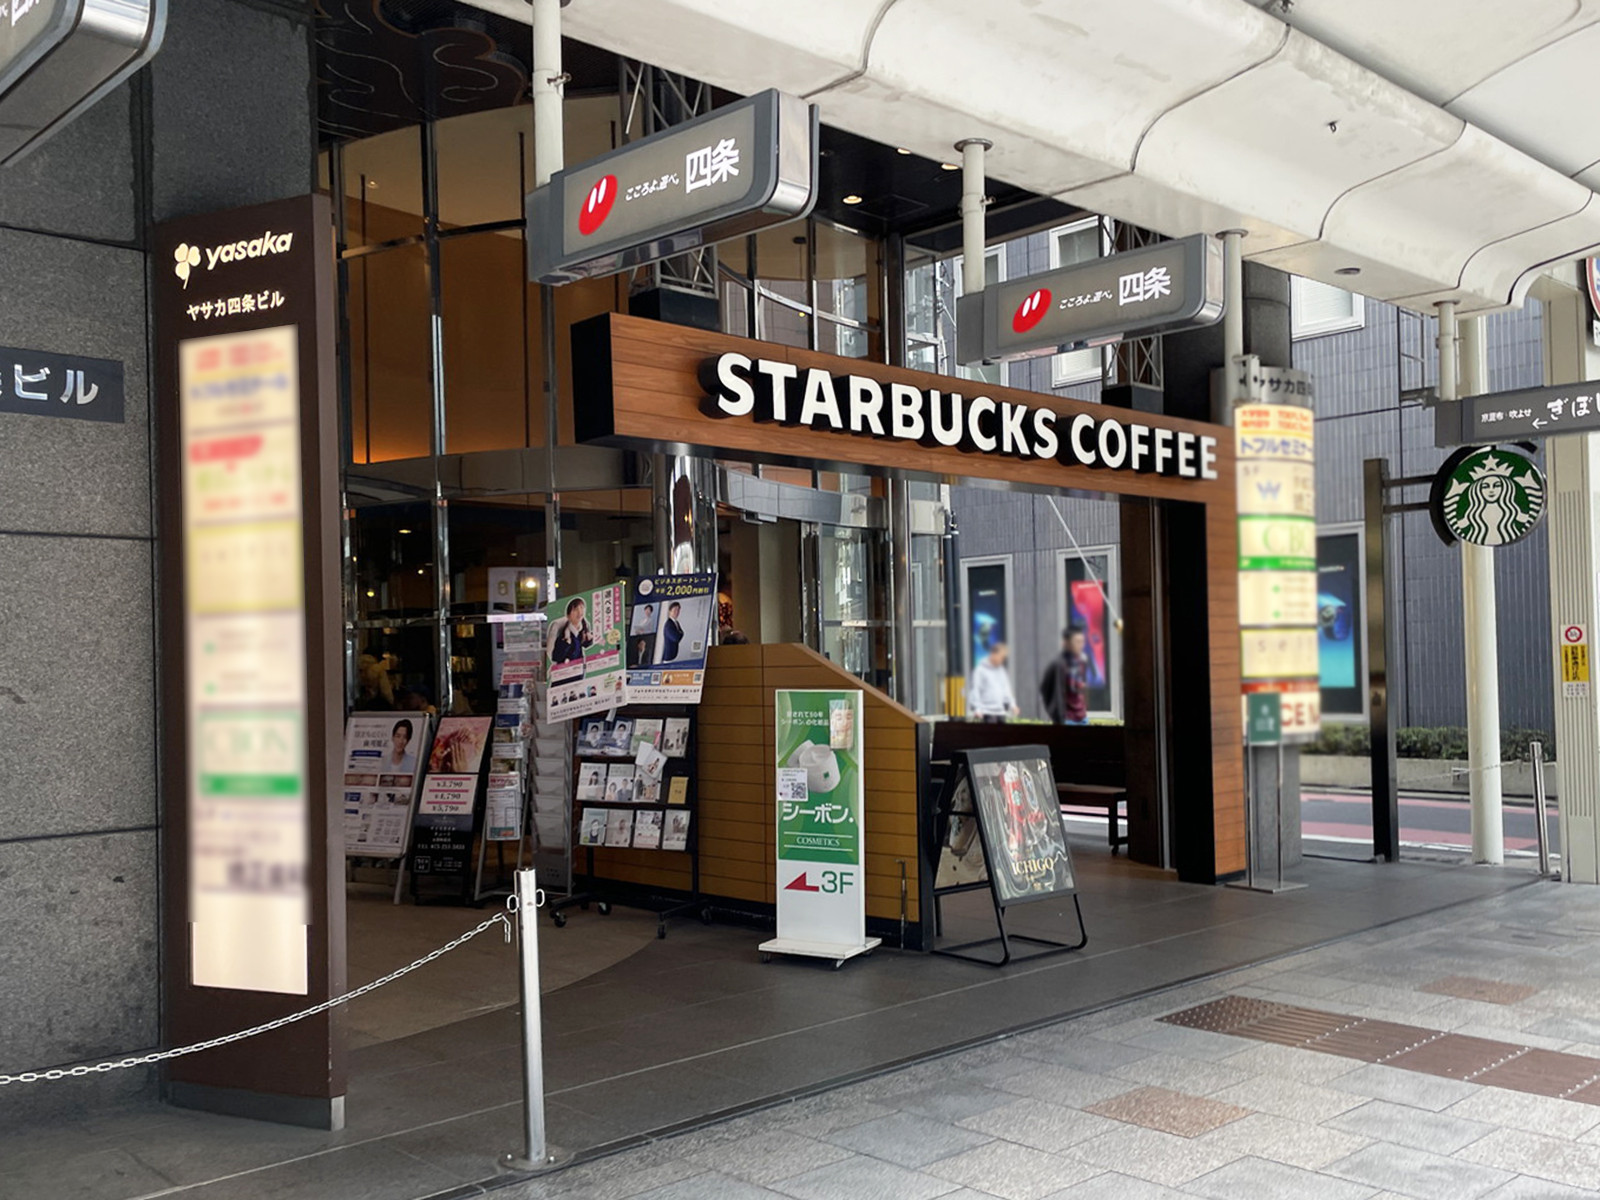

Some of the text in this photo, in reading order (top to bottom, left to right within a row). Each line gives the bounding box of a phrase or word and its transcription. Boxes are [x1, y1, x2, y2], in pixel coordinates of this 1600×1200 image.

[686, 137, 740, 194] 四条
[205, 230, 293, 271] yasaka
[1118, 266, 1171, 306] 四条
[186, 291, 285, 322] ヤサカ四条ビル
[0, 363, 99, 405] ビル
[717, 351, 1218, 480] STARBUCKS COFFEE
[796, 836, 841, 847] COSMETICS
[821, 870, 854, 894] 3F
[1011, 857, 1054, 876] ICHIGO
